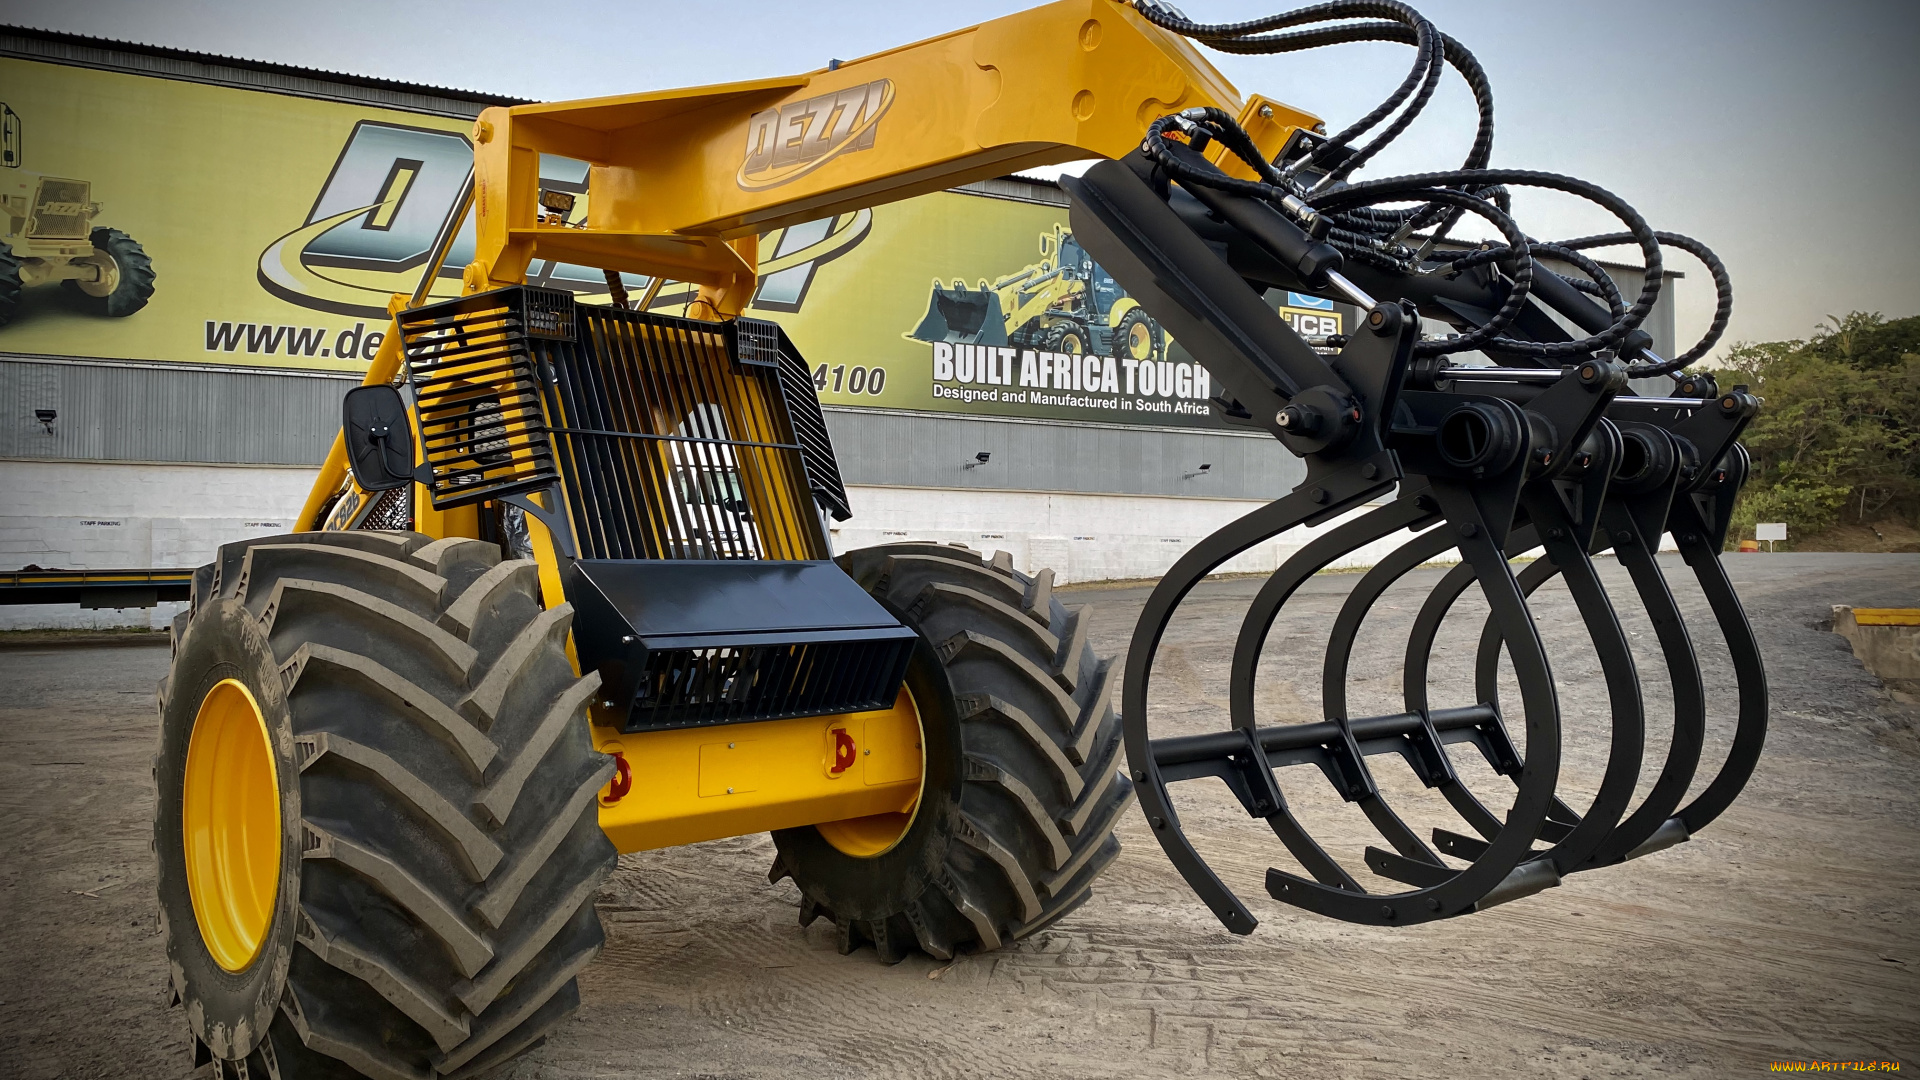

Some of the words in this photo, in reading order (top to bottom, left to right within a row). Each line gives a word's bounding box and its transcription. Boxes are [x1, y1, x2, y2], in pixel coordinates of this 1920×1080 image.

[744, 78, 888, 175] DEZZI
[1292, 314, 1337, 336] JCB
[812, 362, 886, 397] 4100
[933, 341, 1016, 386] BUILT
[1019, 350, 1119, 394] AFRICA
[1122, 358, 1210, 399] TOUGH
[933, 384, 998, 403] Designed
[1001, 389, 1027, 403] and
[1030, 391, 1117, 409] Manufactured
[1121, 398, 1132, 410] in
[1135, 399, 1171, 413] South
[1174, 402, 1210, 416] Africa
